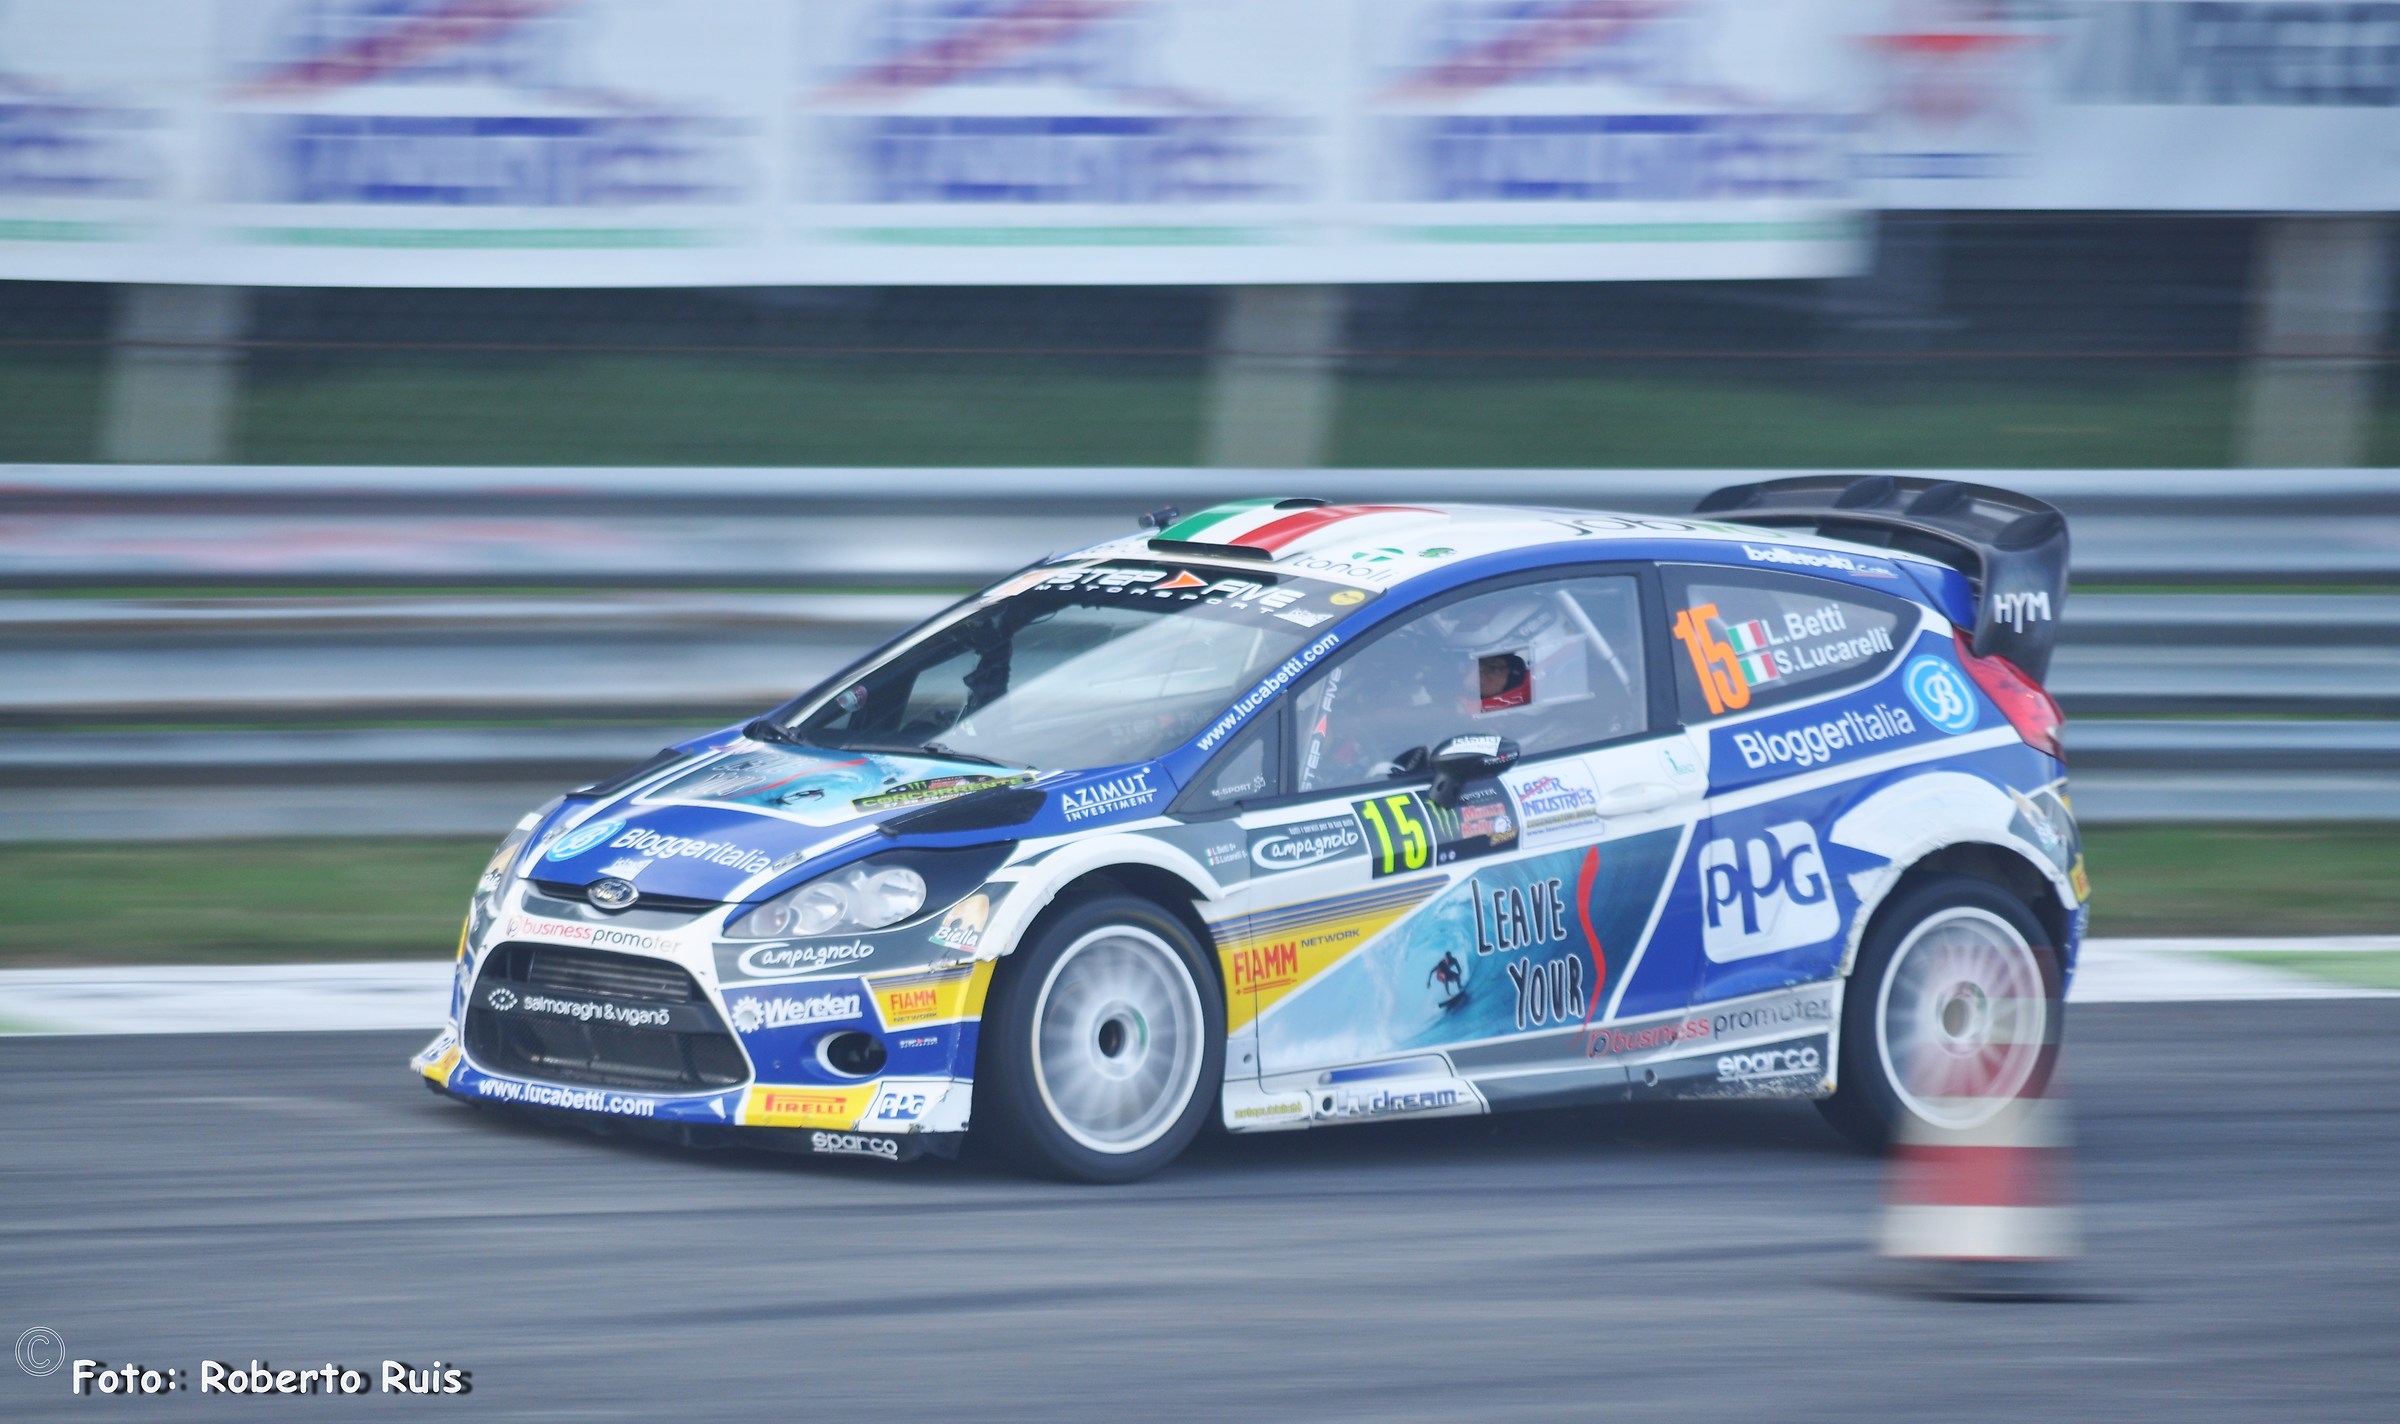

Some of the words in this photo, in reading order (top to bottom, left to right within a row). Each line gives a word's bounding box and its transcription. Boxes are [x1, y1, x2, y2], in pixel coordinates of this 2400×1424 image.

[1047, 566, 1169, 587] STEP
[1201, 579, 1306, 609] FIVE
[1766, 604, 1846, 646] L.Betti
[1993, 592, 2051, 634] HYM
[1673, 603, 1751, 715] 15
[1776, 627, 1894, 676] S.Lucarelli
[1196, 631, 1340, 752] www.lucabetti.com
[1323, 666, 1342, 712] FIVE
[1733, 703, 1916, 769] BloggerItalia
[1062, 773, 1148, 811] AZIMUT
[1212, 783, 1251, 797] M-SPORT
[1513, 776, 1569, 799] LASER
[1521, 788, 1596, 817] INDUSTRIES
[1064, 794, 1154, 822] INVESTIMENT
[610, 828, 772, 875] BloggerItalia
[1252, 829, 1359, 870] Campagnolo
[1361, 794, 1428, 874] 15
[934, 924, 979, 947] Biella
[1472, 877, 1567, 956] LEAVE
[738, 940, 874, 977] Campagnolo
[1234, 941, 1297, 986] FIAMM
[1301, 928, 1360, 948] NETWORK
[764, 994, 862, 1022] Werden
[890, 988, 937, 1011] FIAMM
[1507, 953, 1586, 1030] YOUR
[1716, 1047, 1820, 1080] sparco
[478, 1078, 655, 1117] www.lucabetti.com
[765, 1093, 847, 1114] PIRELLI
[878, 1093, 926, 1120] PPG
[811, 1131, 899, 1157] sparco
